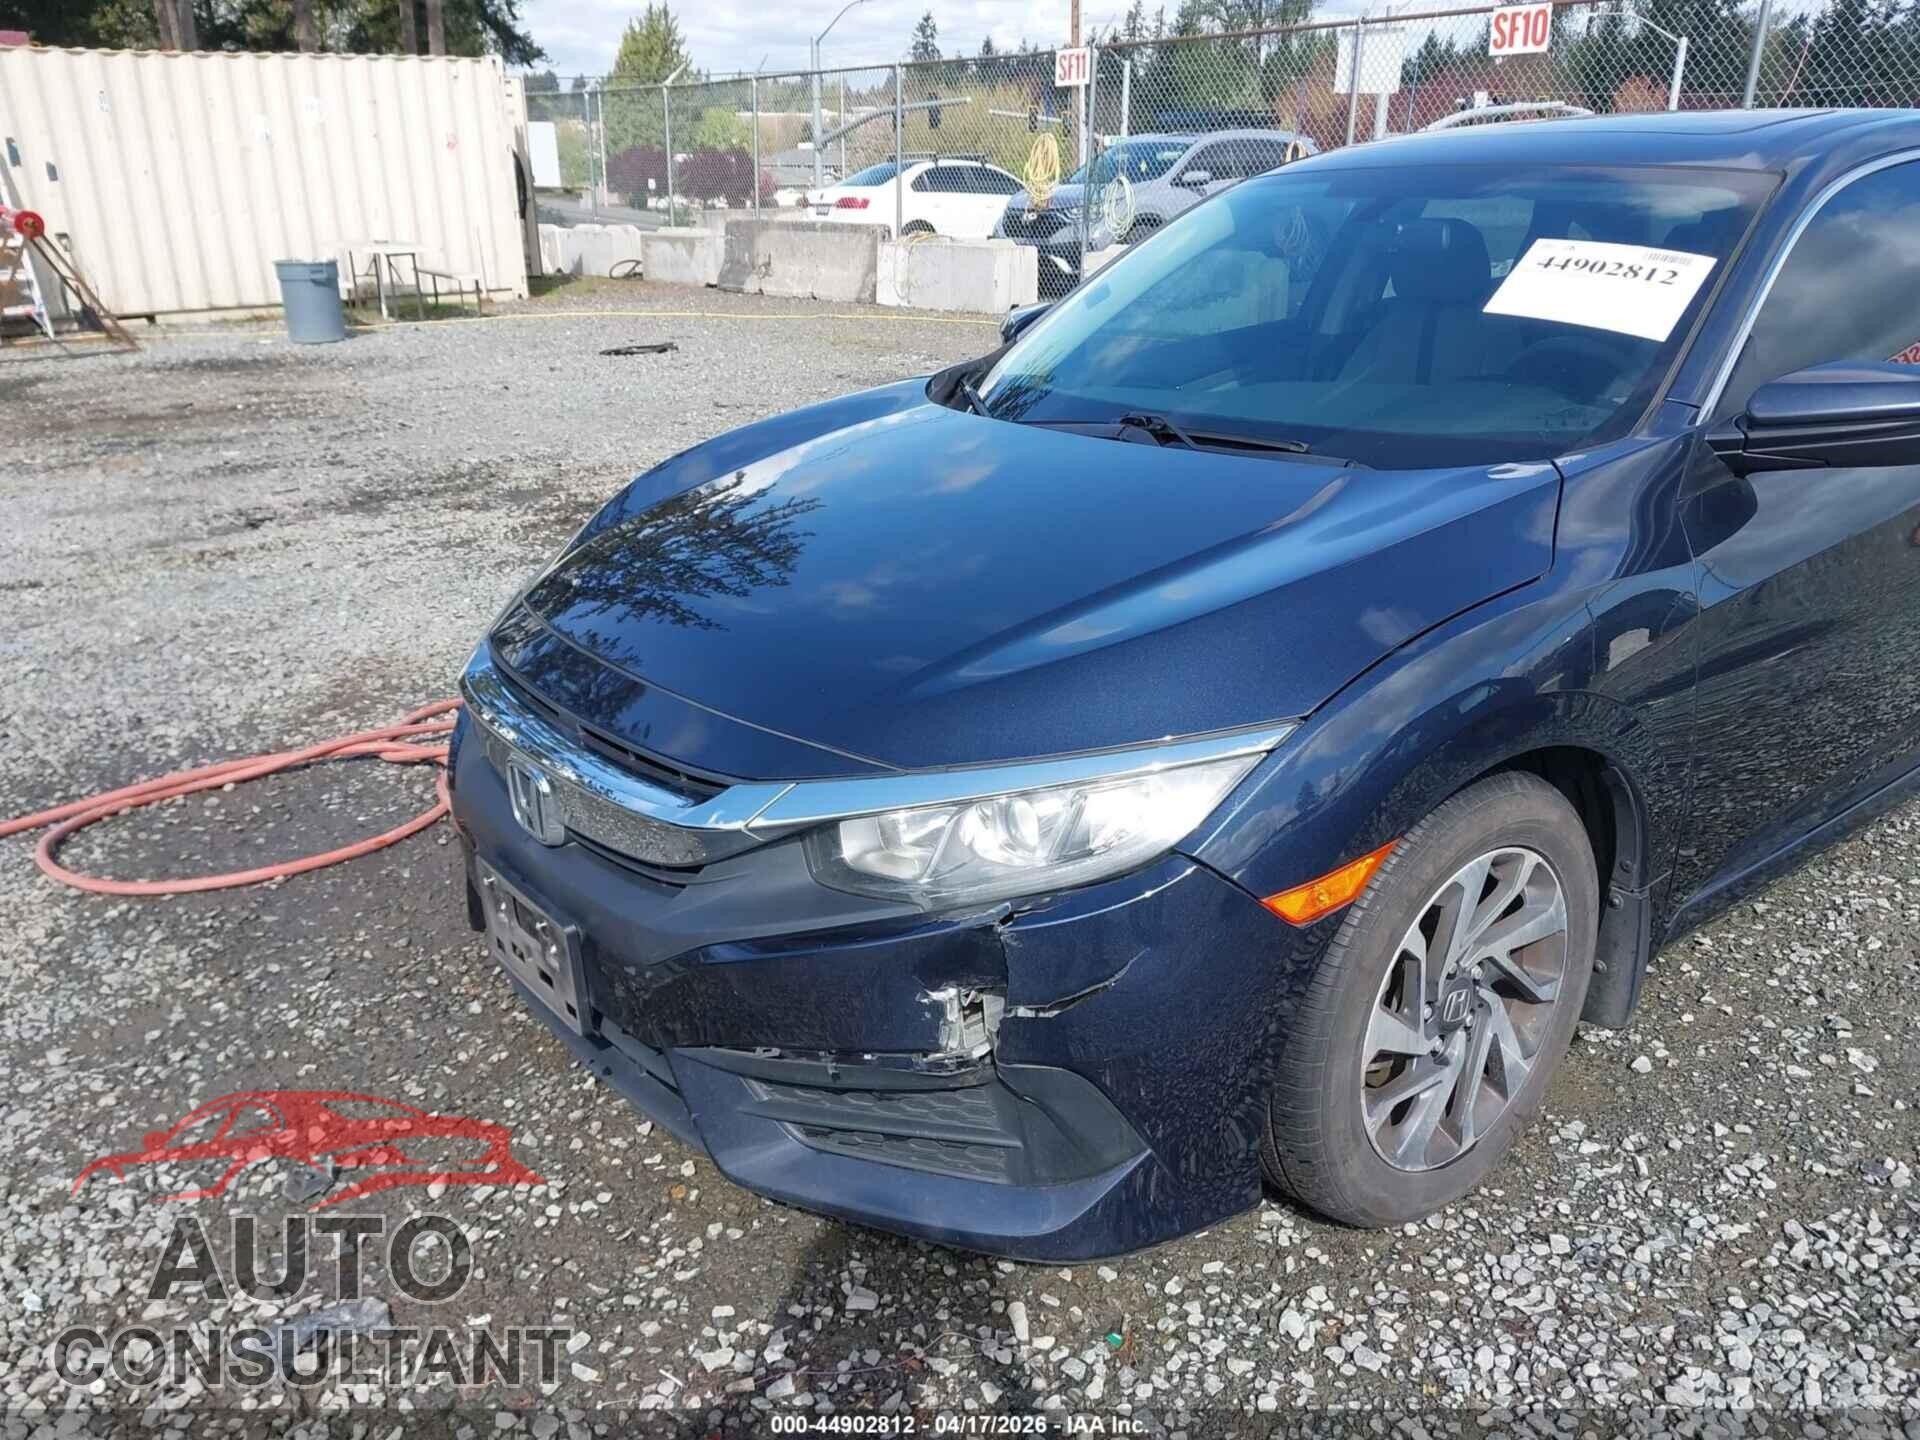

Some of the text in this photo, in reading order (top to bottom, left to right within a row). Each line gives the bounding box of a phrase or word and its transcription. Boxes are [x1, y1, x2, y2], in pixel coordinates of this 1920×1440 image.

[1493, 9, 1548, 49] SF10
[1059, 53, 1086, 80] SF11
[1537, 256, 1679, 285] 44902812
